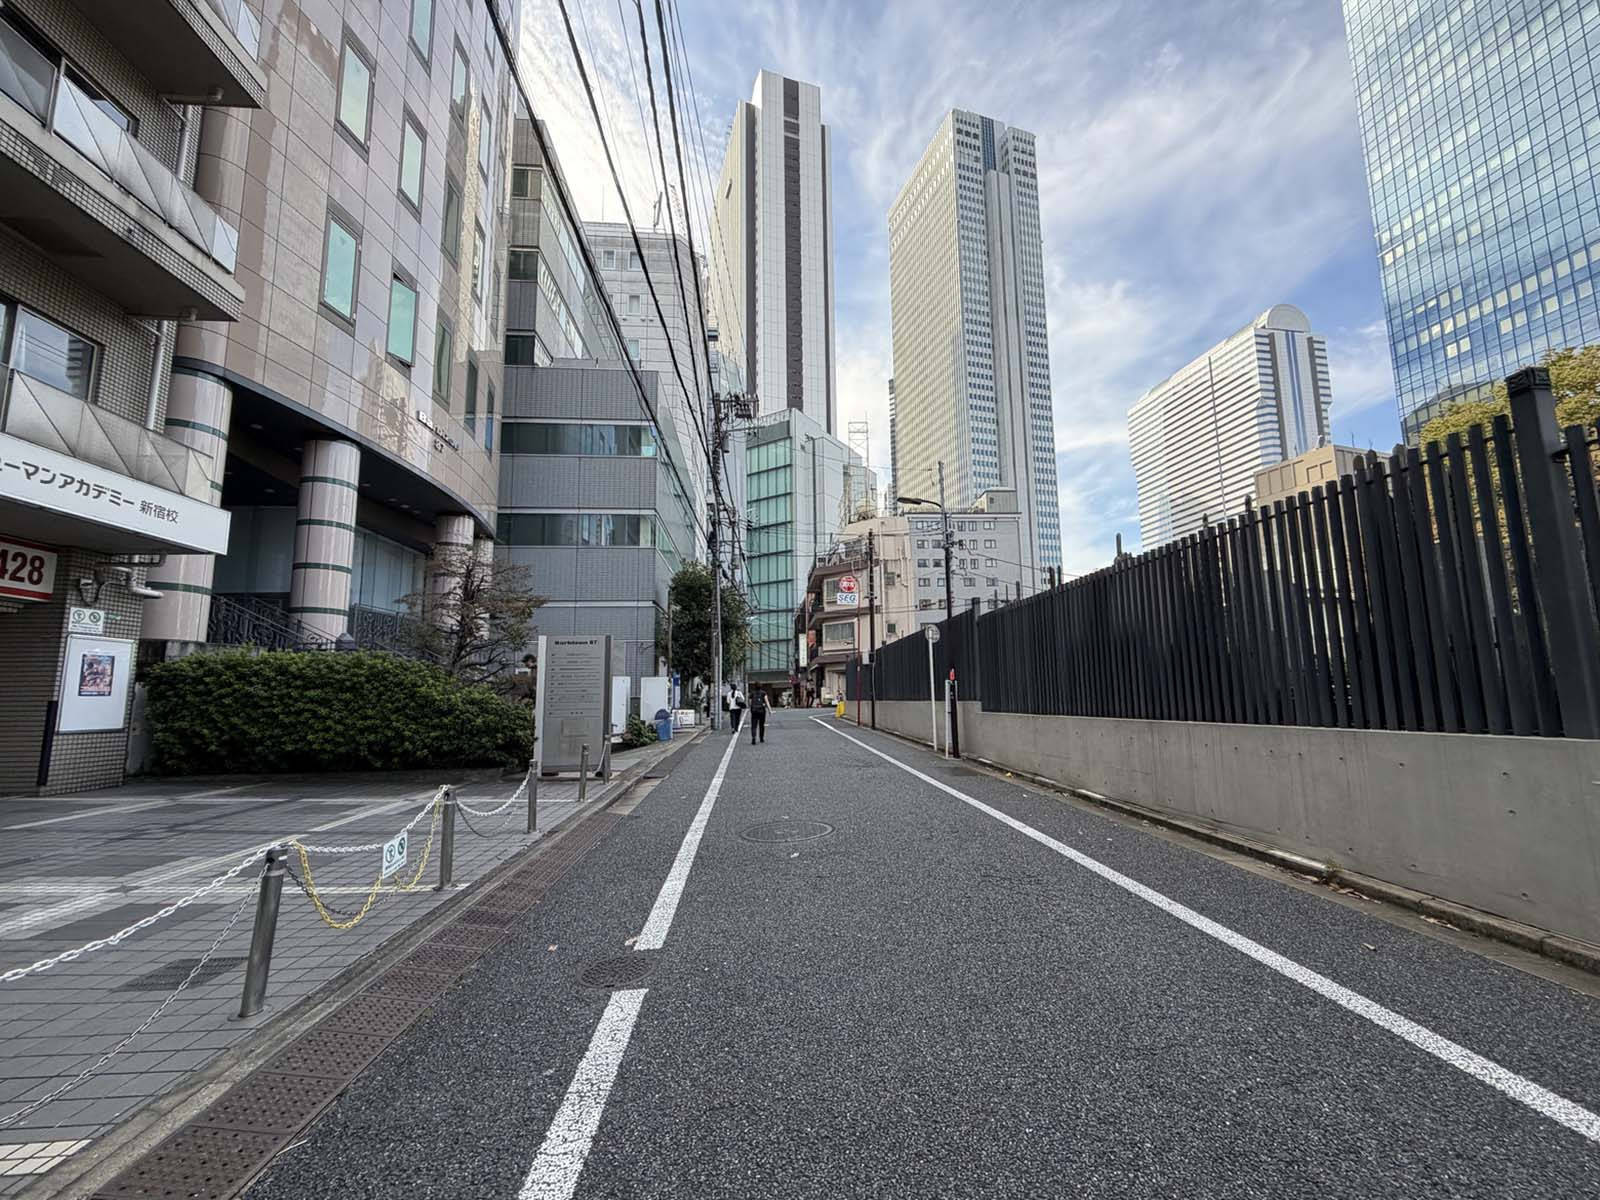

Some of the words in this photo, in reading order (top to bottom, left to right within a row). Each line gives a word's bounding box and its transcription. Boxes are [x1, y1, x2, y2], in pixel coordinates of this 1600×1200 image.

[0, 458, 135, 506] ーマンアカデミー
[139, 500, 179, 524] 新宿校
[838, 594, 856, 602] SEG
